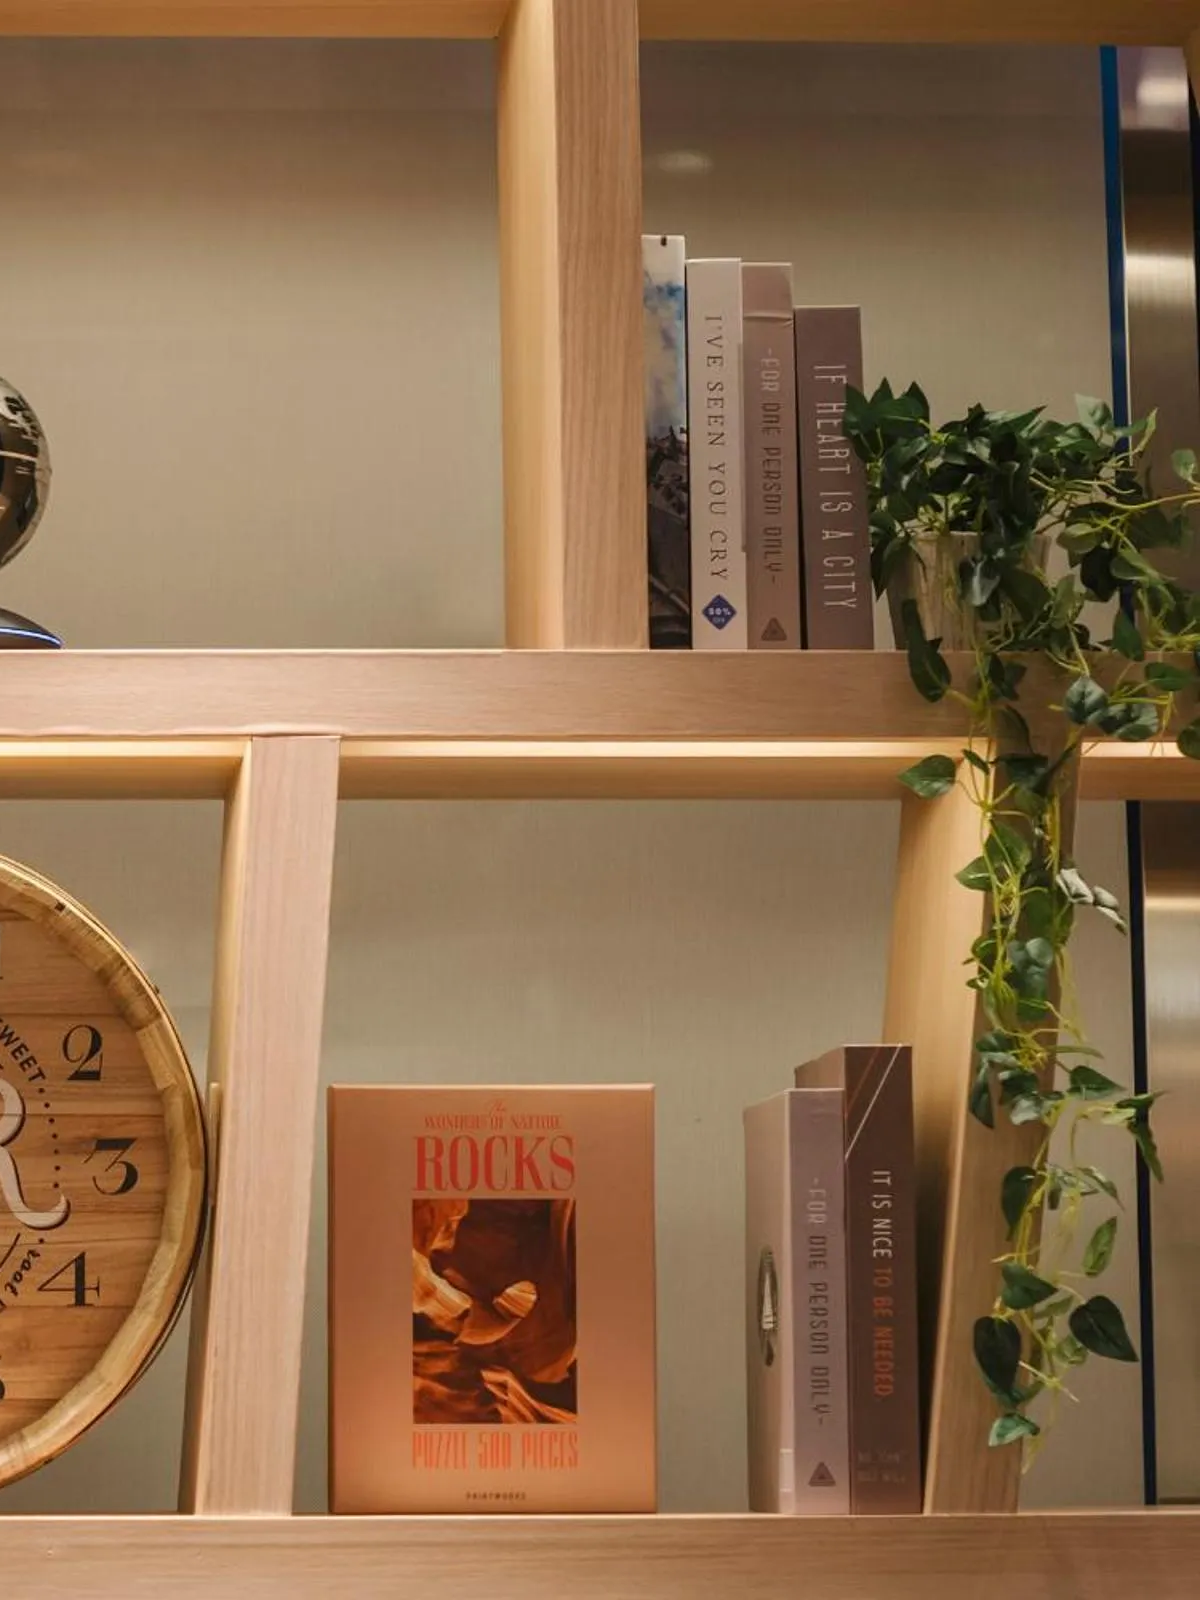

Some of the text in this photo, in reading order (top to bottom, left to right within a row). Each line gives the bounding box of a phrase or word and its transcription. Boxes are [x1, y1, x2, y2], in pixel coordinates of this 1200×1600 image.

[704, 315, 729, 580] I'VE SEEN YOU CRY
[813, 364, 858, 609] IF HEART IS A CITY
[61, 1023, 103, 1082] 2
[88, 1136, 139, 1196] 3
[412, 1134, 576, 1192] ROCKS
[36, 1250, 101, 1309] 4
[872, 1170, 895, 1397] IT IS NICE TO BE NEEDED
[412, 1430, 579, 1469] PUZZLE 500 PIECES
